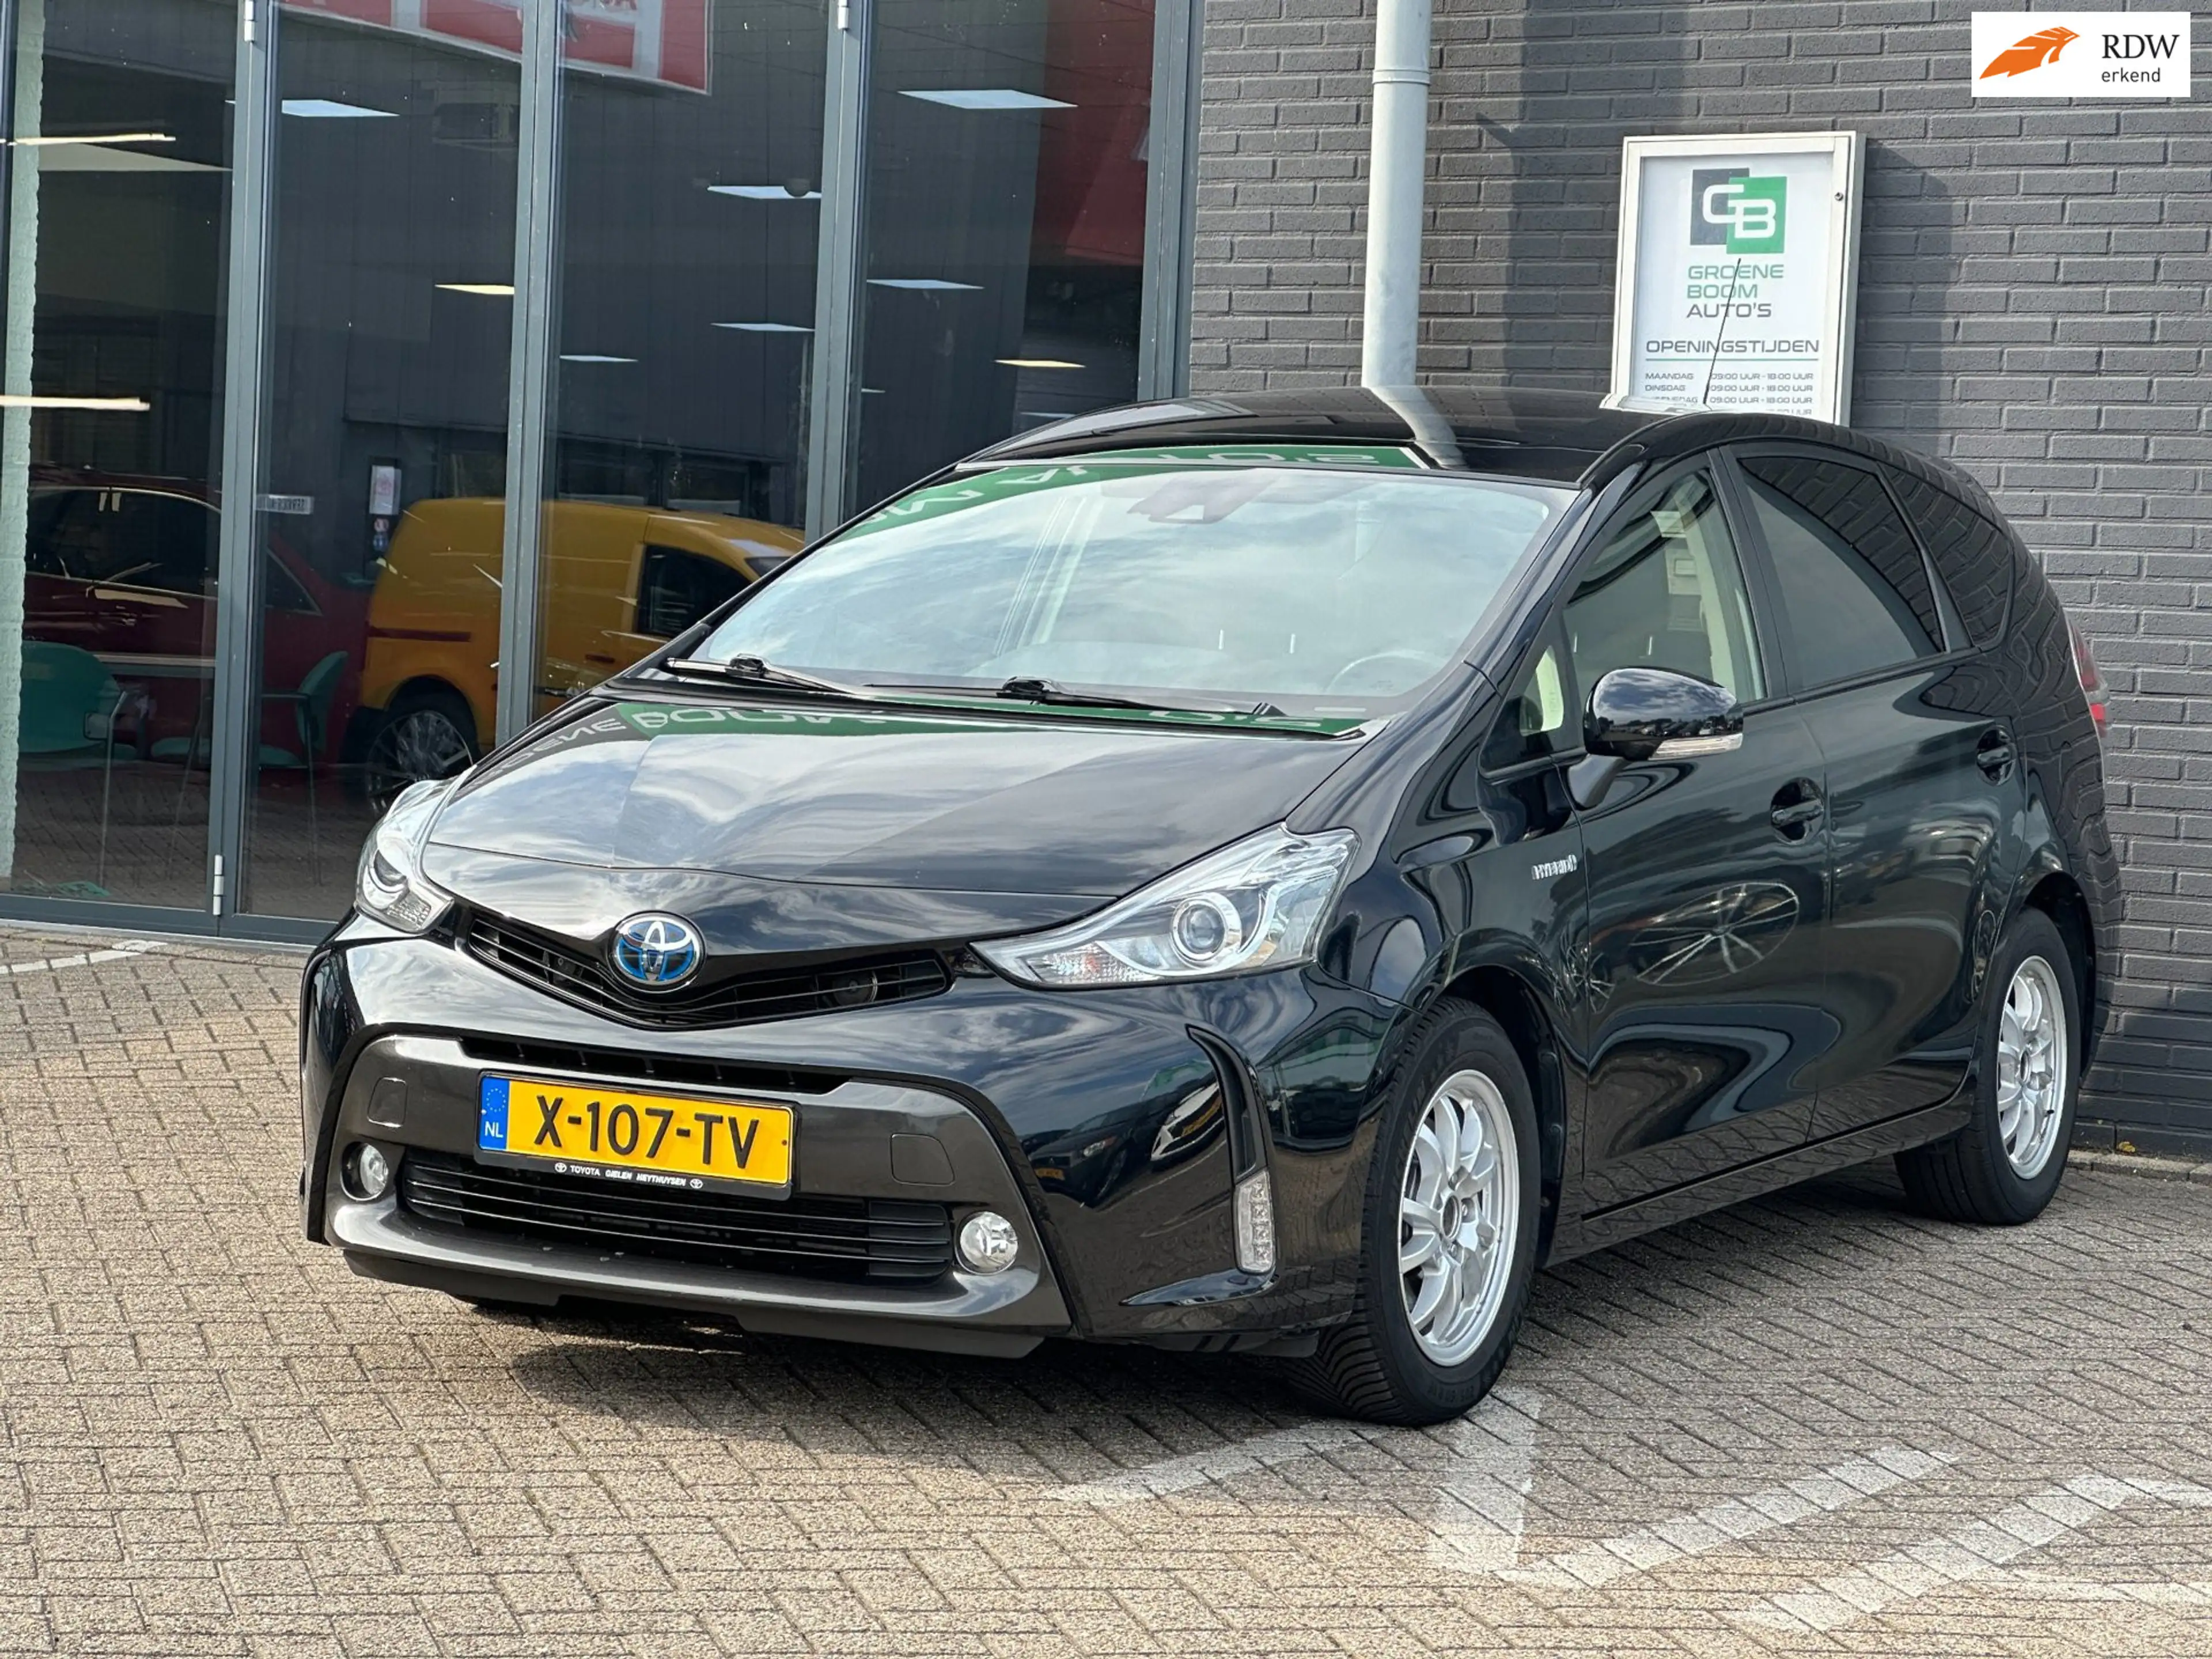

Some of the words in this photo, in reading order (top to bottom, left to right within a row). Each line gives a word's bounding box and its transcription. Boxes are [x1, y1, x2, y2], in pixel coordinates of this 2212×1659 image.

[1688, 264, 1785, 279] GROENE
[1687, 284, 1758, 298] BOOM
[1687, 302, 1772, 318] AUTO'S
[1646, 339, 1820, 353] OPENINGSTIJDEN
[484, 1121, 504, 1139] NL
[534, 1095, 759, 1169] X-107-TV
[570, 1165, 601, 1176] TOYOTA
